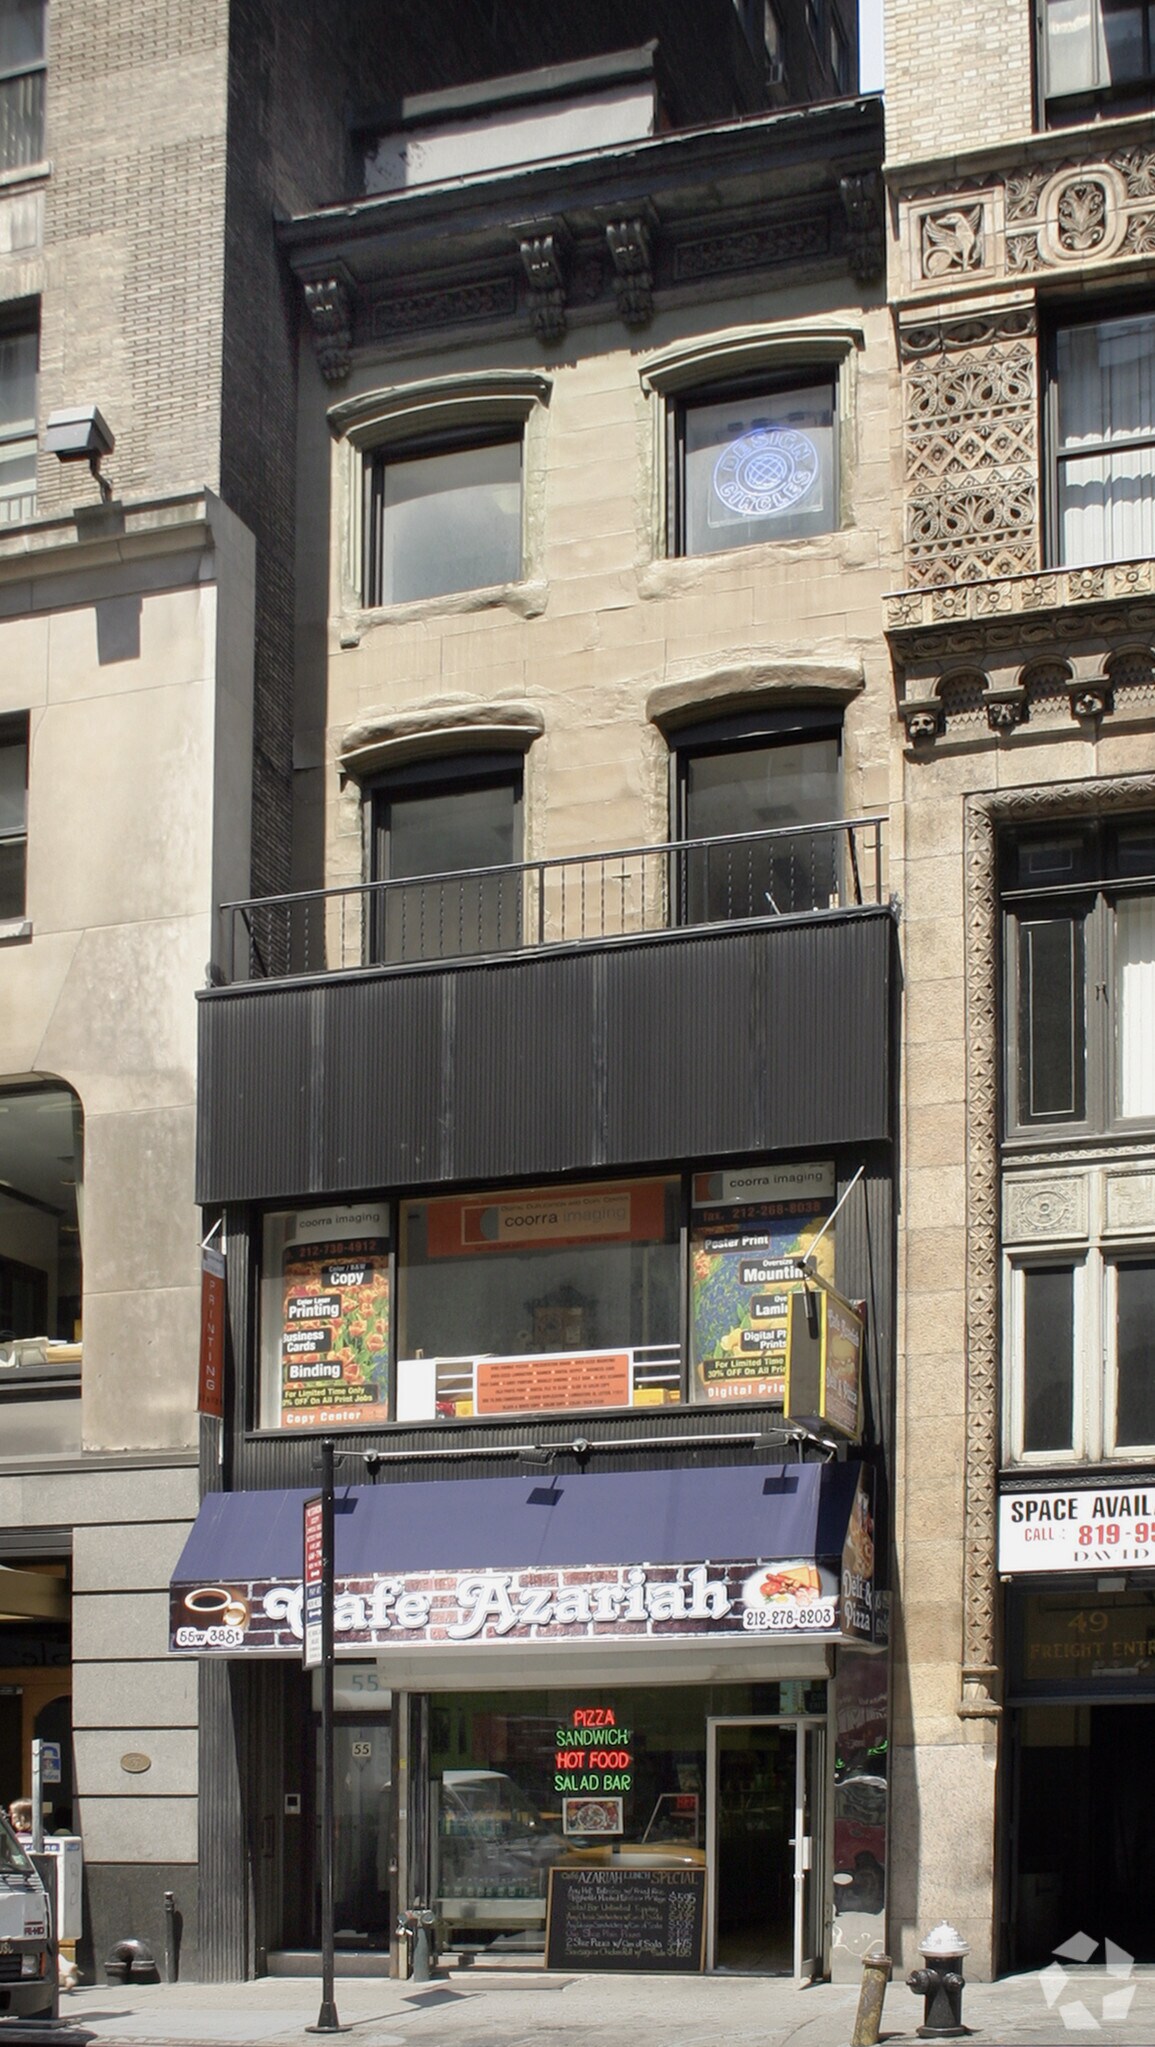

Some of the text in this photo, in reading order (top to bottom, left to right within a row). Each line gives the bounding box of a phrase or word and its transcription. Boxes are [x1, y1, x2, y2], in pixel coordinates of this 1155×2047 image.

[721, 431, 812, 472] DESIGN
[719, 470, 811, 512] CIRCLES
[730, 1172, 822, 1188] coorra imaging
[300, 1213, 380, 1228] coorra imaging
[504, 1205, 626, 1228] coorra imaging
[705, 1235, 769, 1250] Poster Print
[762, 1259, 794, 1268] Oversize
[330, 1272, 364, 1286] Copy
[743, 1265, 808, 1283] Mountin
[288, 1304, 340, 1319] Printing
[205, 1280, 216, 1391] PRINTING
[743, 1331, 775, 1342] Digital
[286, 1342, 316, 1353] Cards
[715, 1357, 785, 1369] For Limited Time
[289, 1364, 341, 1379] Binding
[708, 1370, 724, 1378] 30%
[726, 1368, 742, 1377] OFF
[744, 1367, 756, 1375] On
[757, 1366, 769, 1374] All
[298, 1388, 326, 1397] Limited
[328, 1387, 347, 1395] Time
[348, 1387, 365, 1395] Only
[707, 1383, 786, 1398] Digital Prin
[294, 1398, 308, 1406] OFF
[310, 1397, 321, 1405] On
[322, 1396, 333, 1404] All
[334, 1395, 353, 1403] Print
[286, 1411, 361, 1424] Copy Center
[1011, 1494, 1155, 1523] SPACE AVAIL
[1024, 1527, 1055, 1542] CALL
[1074, 1548, 1150, 1562] DAVID
[843, 1570, 863, 1599] Deli
[263, 1568, 732, 1640] Cafe Azariah
[746, 1608, 832, 1627] 212-278-8203
[843, 1600, 871, 1632] Pizza
[1067, 1611, 1109, 1633] 49
[1029, 1641, 1104, 1659] FREIGHT
[351, 1674, 379, 1692] 55
[573, 1709, 615, 1727] PIZZA
[555, 1728, 629, 1747] SANDWICH
[353, 1743, 370, 1755] 55
[556, 1751, 631, 1769] HOT FOOD
[554, 1774, 631, 1791] SALAD BAR
[578, 1871, 624, 1885] AZARIAH
[651, 1871, 699, 1885] SPECIAL
